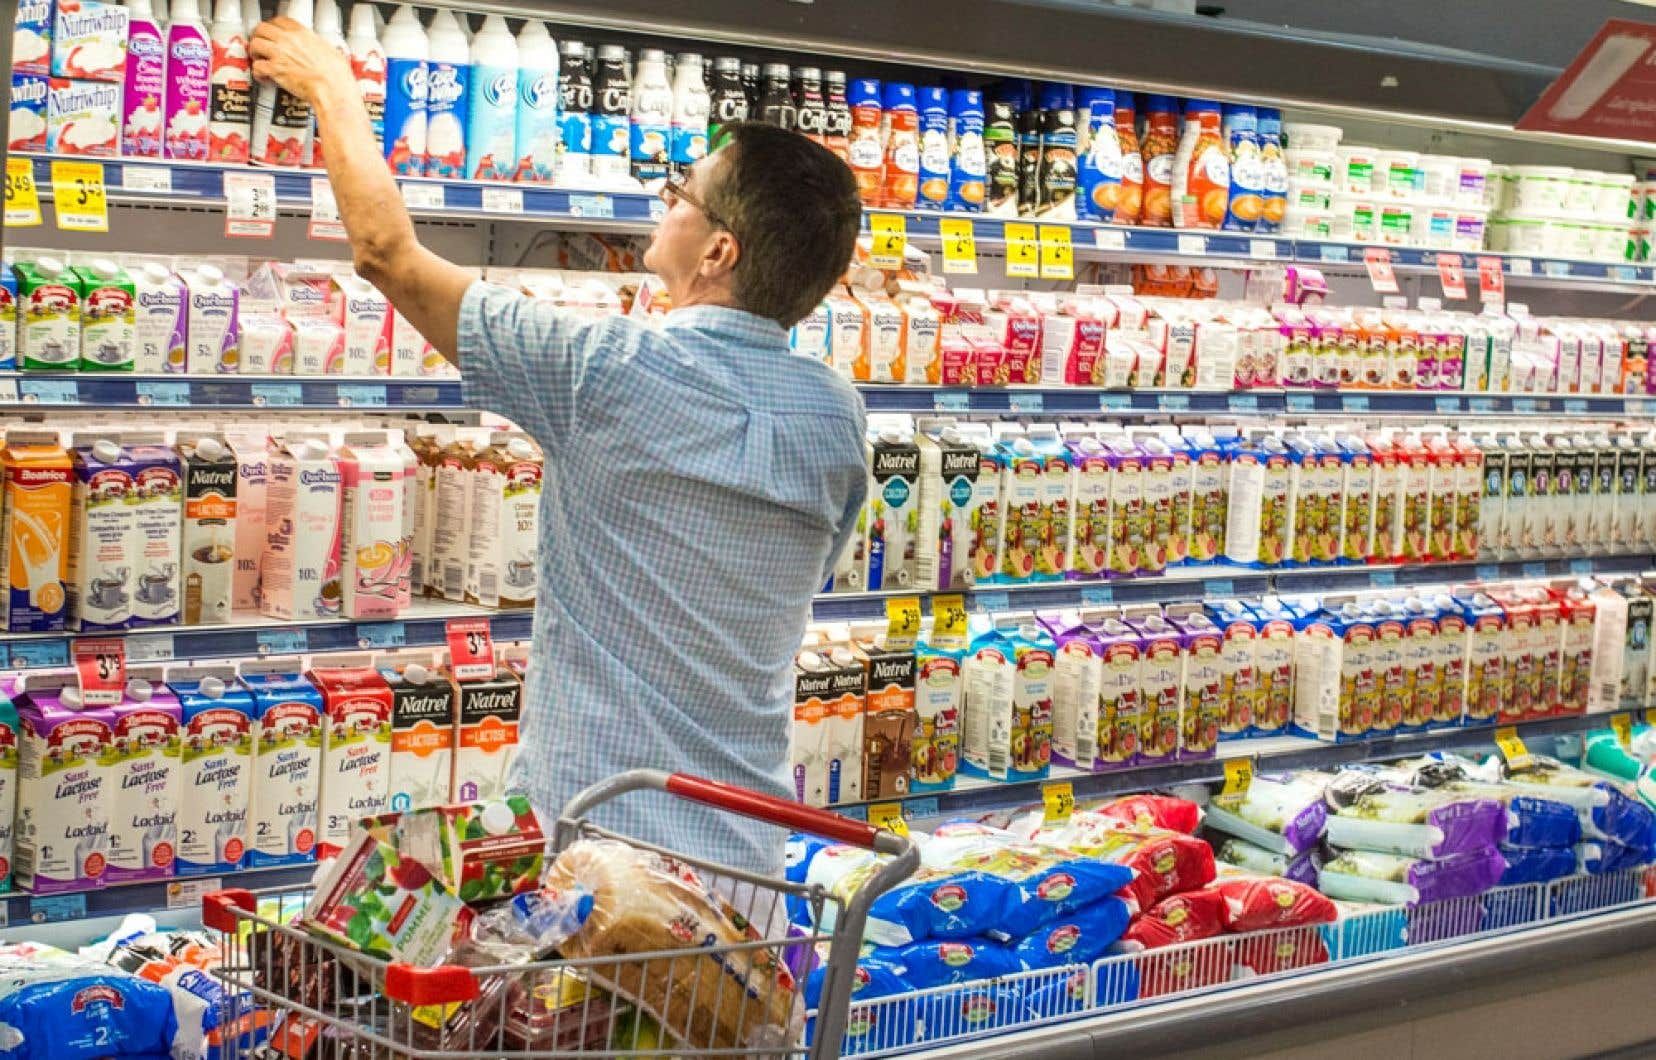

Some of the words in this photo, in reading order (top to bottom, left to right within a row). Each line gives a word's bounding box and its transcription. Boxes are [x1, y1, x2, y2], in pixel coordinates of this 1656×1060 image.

[878, 453, 917, 470] Natrel
[944, 453, 978, 470] Natrel
[191, 470, 234, 485] Natrel
[874, 660, 912, 678] Natrel
[800, 679, 830, 693] Natrel
[832, 673, 862, 688] Natrel
[398, 694, 450, 714] Natrel
[467, 689, 517, 710] Natrel
[269, 756, 311, 779] Lactose
[339, 752, 381, 773] Lactose
[122, 767, 169, 789] Lactose
[195, 764, 240, 786] Lactose
[55, 777, 102, 799] Lactose
